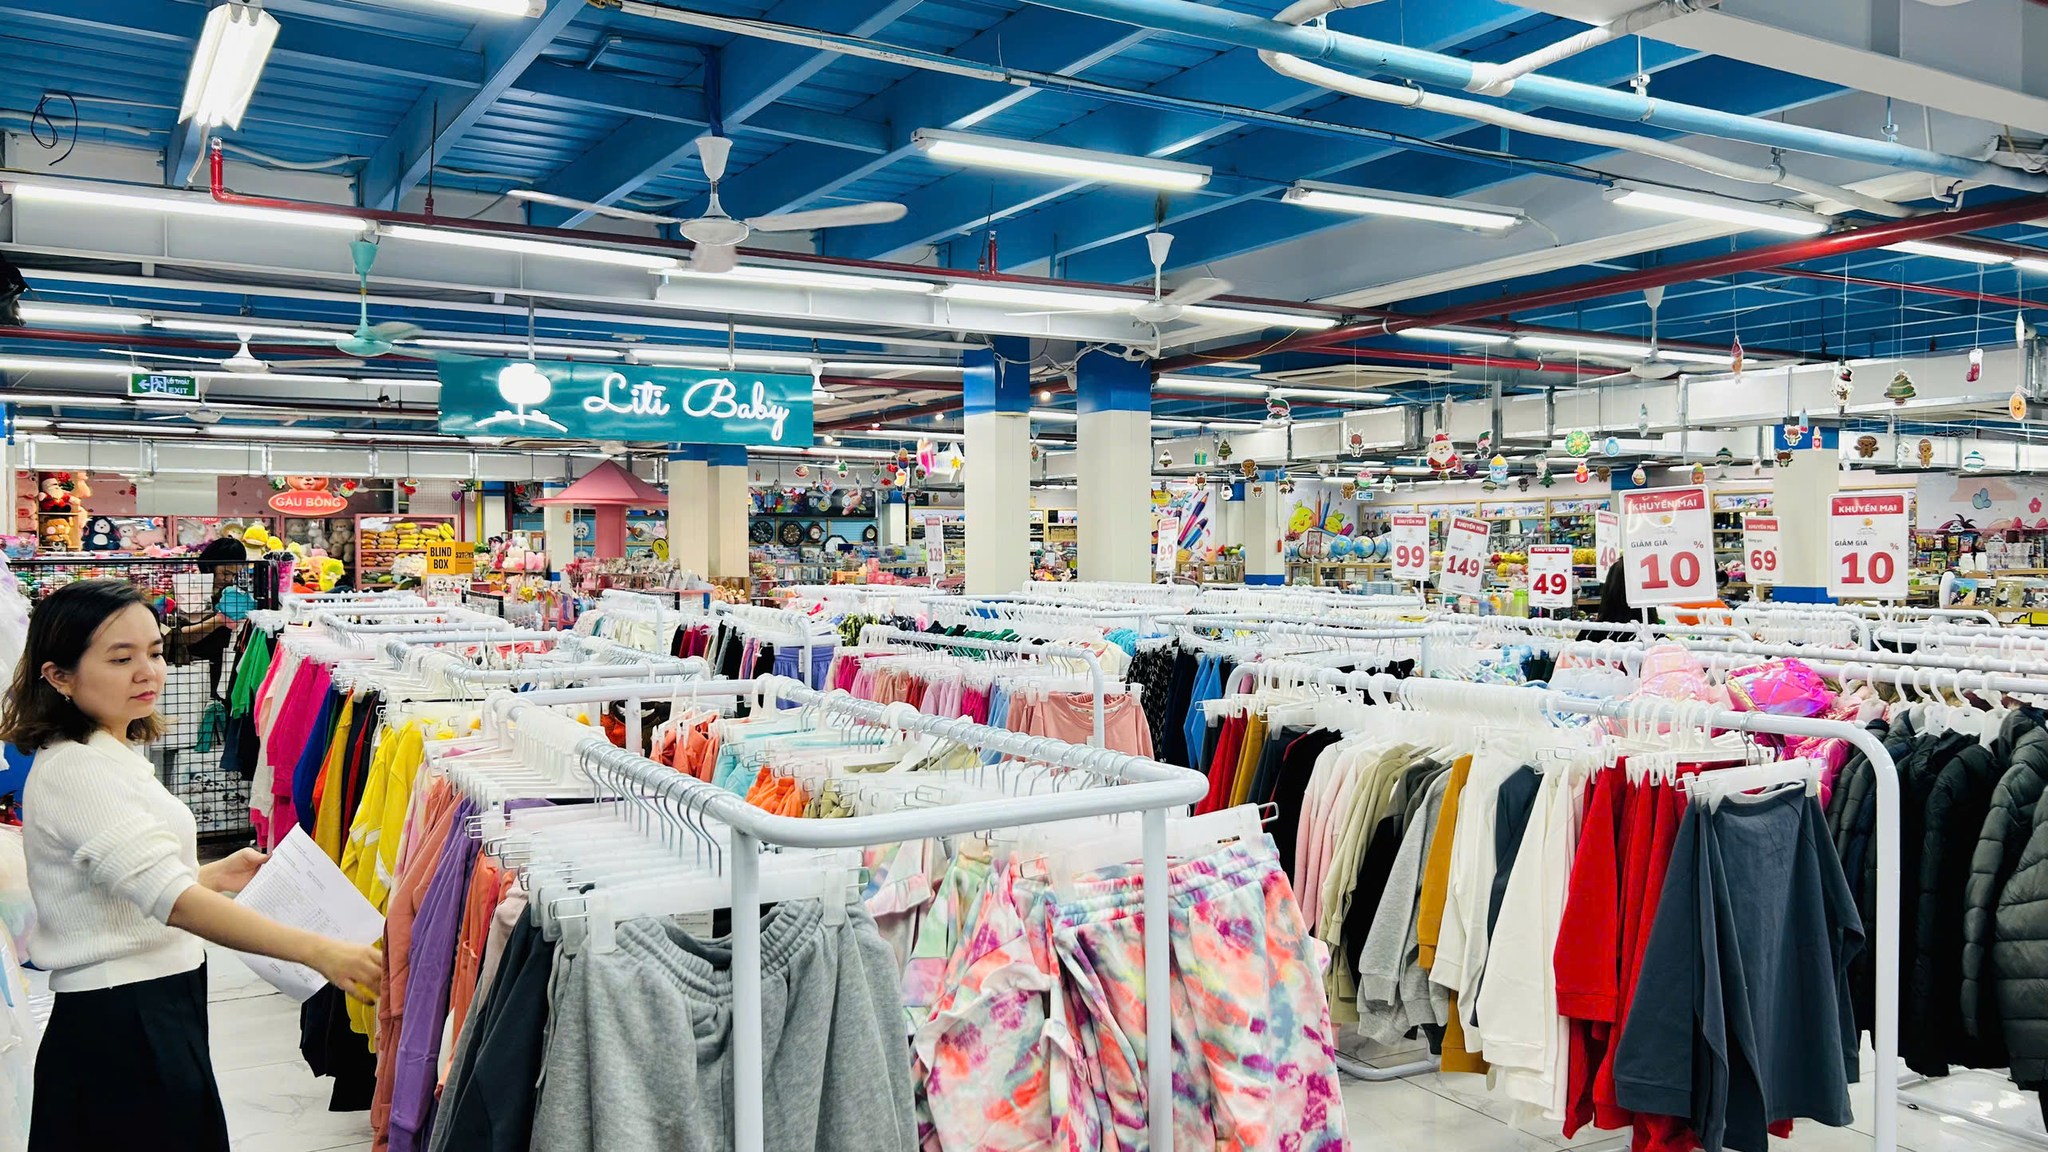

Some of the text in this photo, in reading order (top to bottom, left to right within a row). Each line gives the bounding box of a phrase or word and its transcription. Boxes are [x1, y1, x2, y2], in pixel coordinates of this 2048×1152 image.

[583, 372, 790, 441] Liti Baby
[430, 546, 452, 557] BLIND
[929, 548, 942, 562] 129
[1160, 544, 1173, 561] 99
[1693, 540, 1704, 549] %
[1890, 542, 1899, 550] %
[433, 559, 449, 569] BOX
[1396, 545, 1424, 568] 99
[1446, 554, 1480, 577] 149
[1750, 549, 1777, 571] 69
[1841, 551, 1894, 584] 10
[1640, 551, 1700, 589] 10
[1533, 573, 1567, 595] 49
